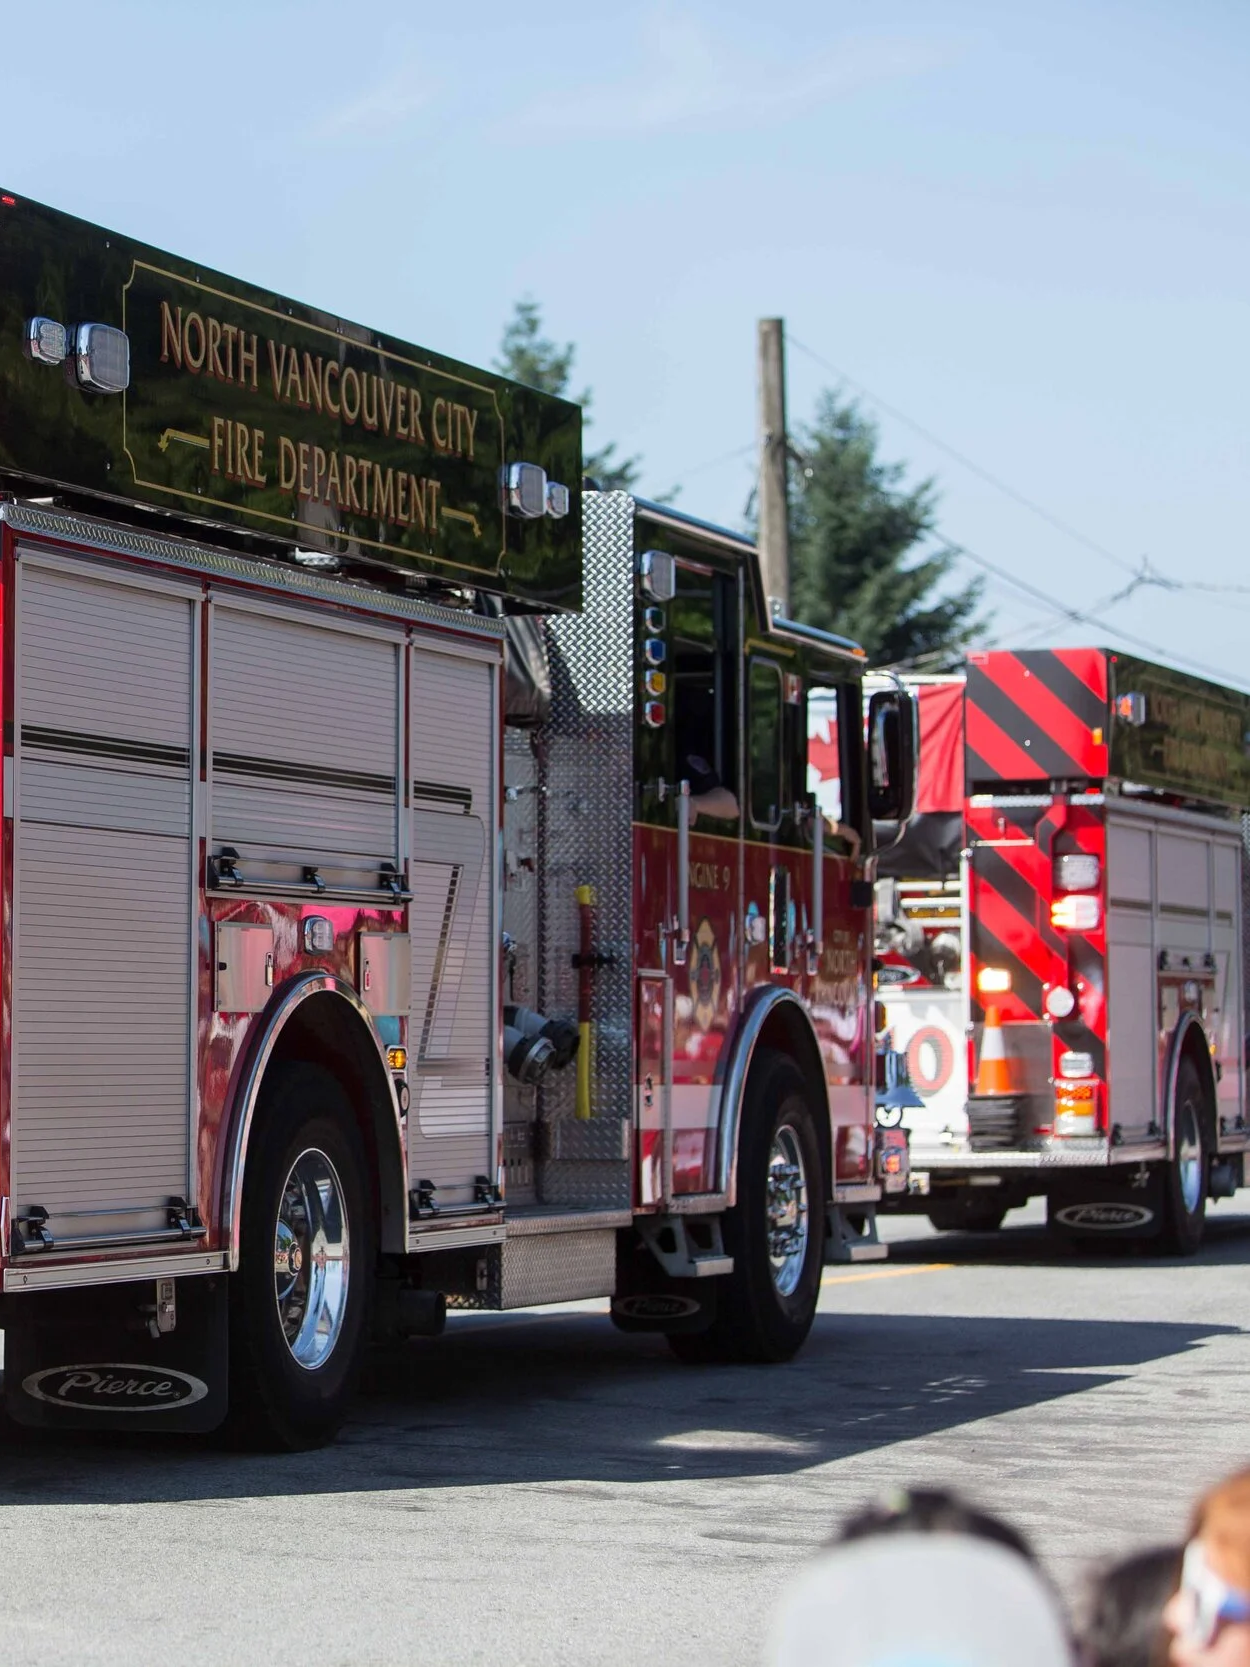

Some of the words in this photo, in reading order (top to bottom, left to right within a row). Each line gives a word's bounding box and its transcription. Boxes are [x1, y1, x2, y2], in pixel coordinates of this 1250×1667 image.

[160, 300, 258, 392] NORTH
[267, 339, 425, 446] VANCOUVER
[431, 397, 478, 462] CITY
[211, 416, 267, 489] FIRE
[277, 436, 442, 535] DEPARTMENT
[688, 861, 720, 890] NGINE
[723, 865, 731, 892] 9
[57, 1371, 173, 1397] Pierce
